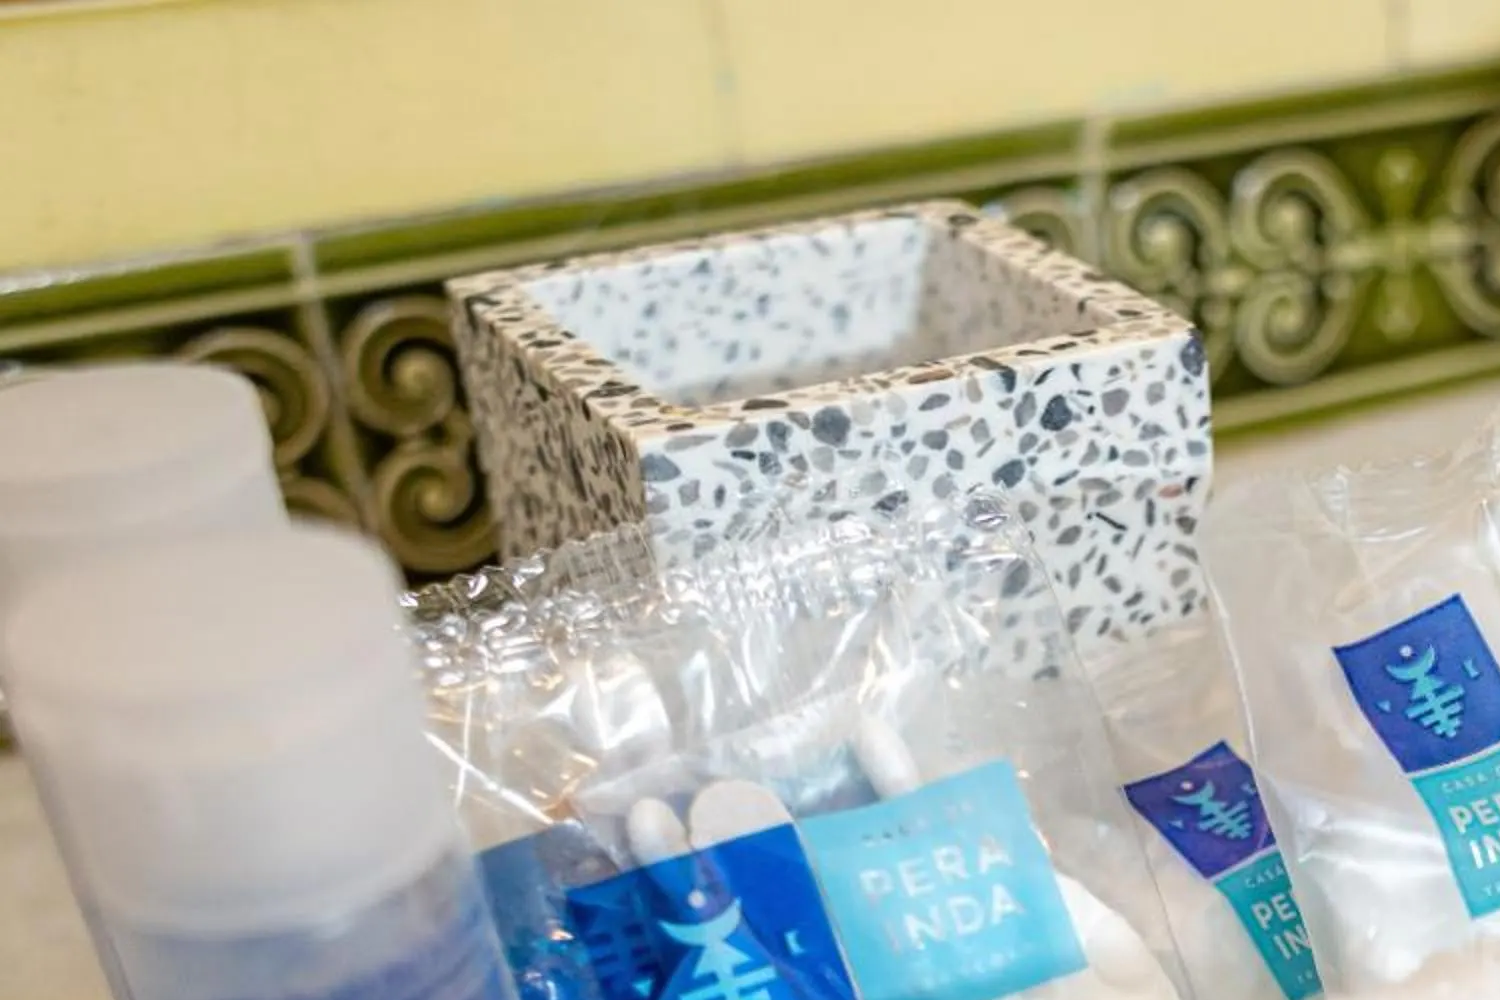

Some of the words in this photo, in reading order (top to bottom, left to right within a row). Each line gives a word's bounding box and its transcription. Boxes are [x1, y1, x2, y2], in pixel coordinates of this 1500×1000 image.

[859, 834, 1014, 901] PERA
[886, 883, 1026, 952] INDA
[1252, 892, 1297, 930] PE
[1272, 924, 1312, 960] IN
